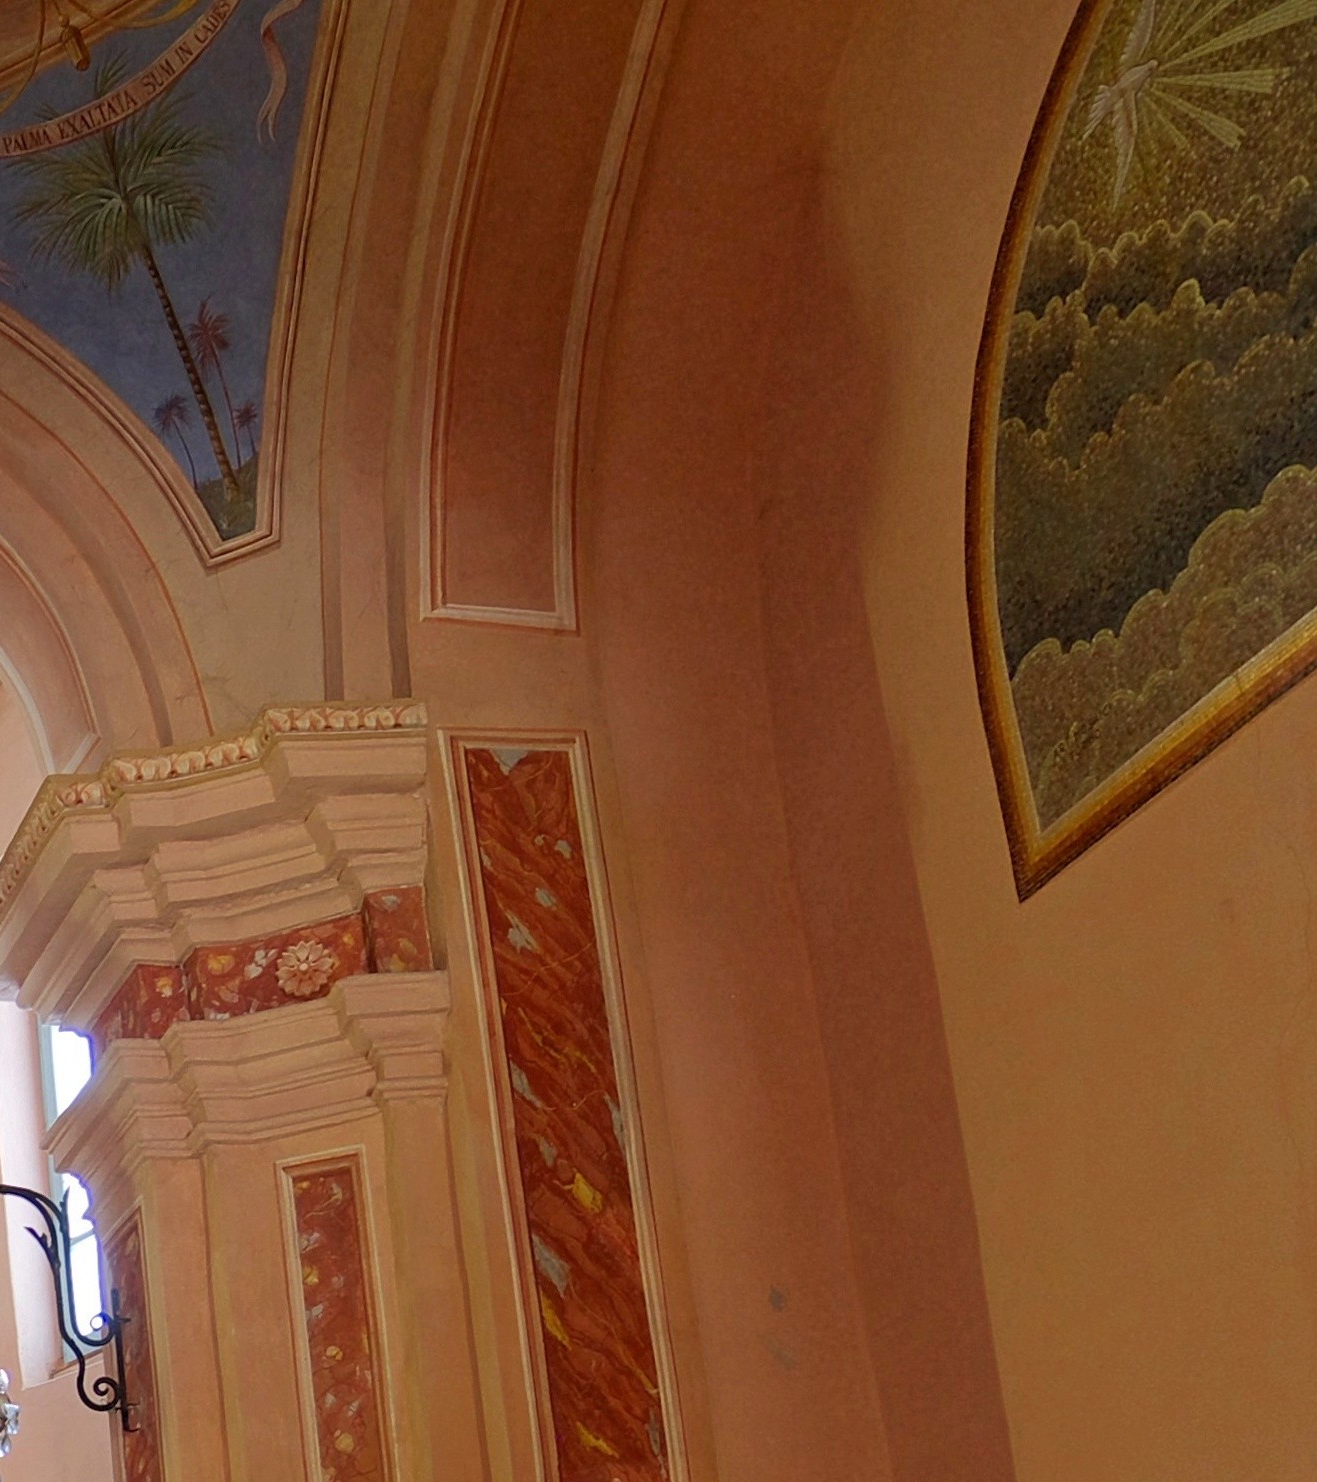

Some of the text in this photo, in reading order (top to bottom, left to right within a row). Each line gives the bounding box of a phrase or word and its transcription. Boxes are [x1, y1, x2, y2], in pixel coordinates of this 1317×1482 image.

[3, 130, 51, 153] PALMA
[58, 91, 138, 140] EXALTATA
[142, 62, 176, 95] SUM
[175, 43, 194, 64] IN
